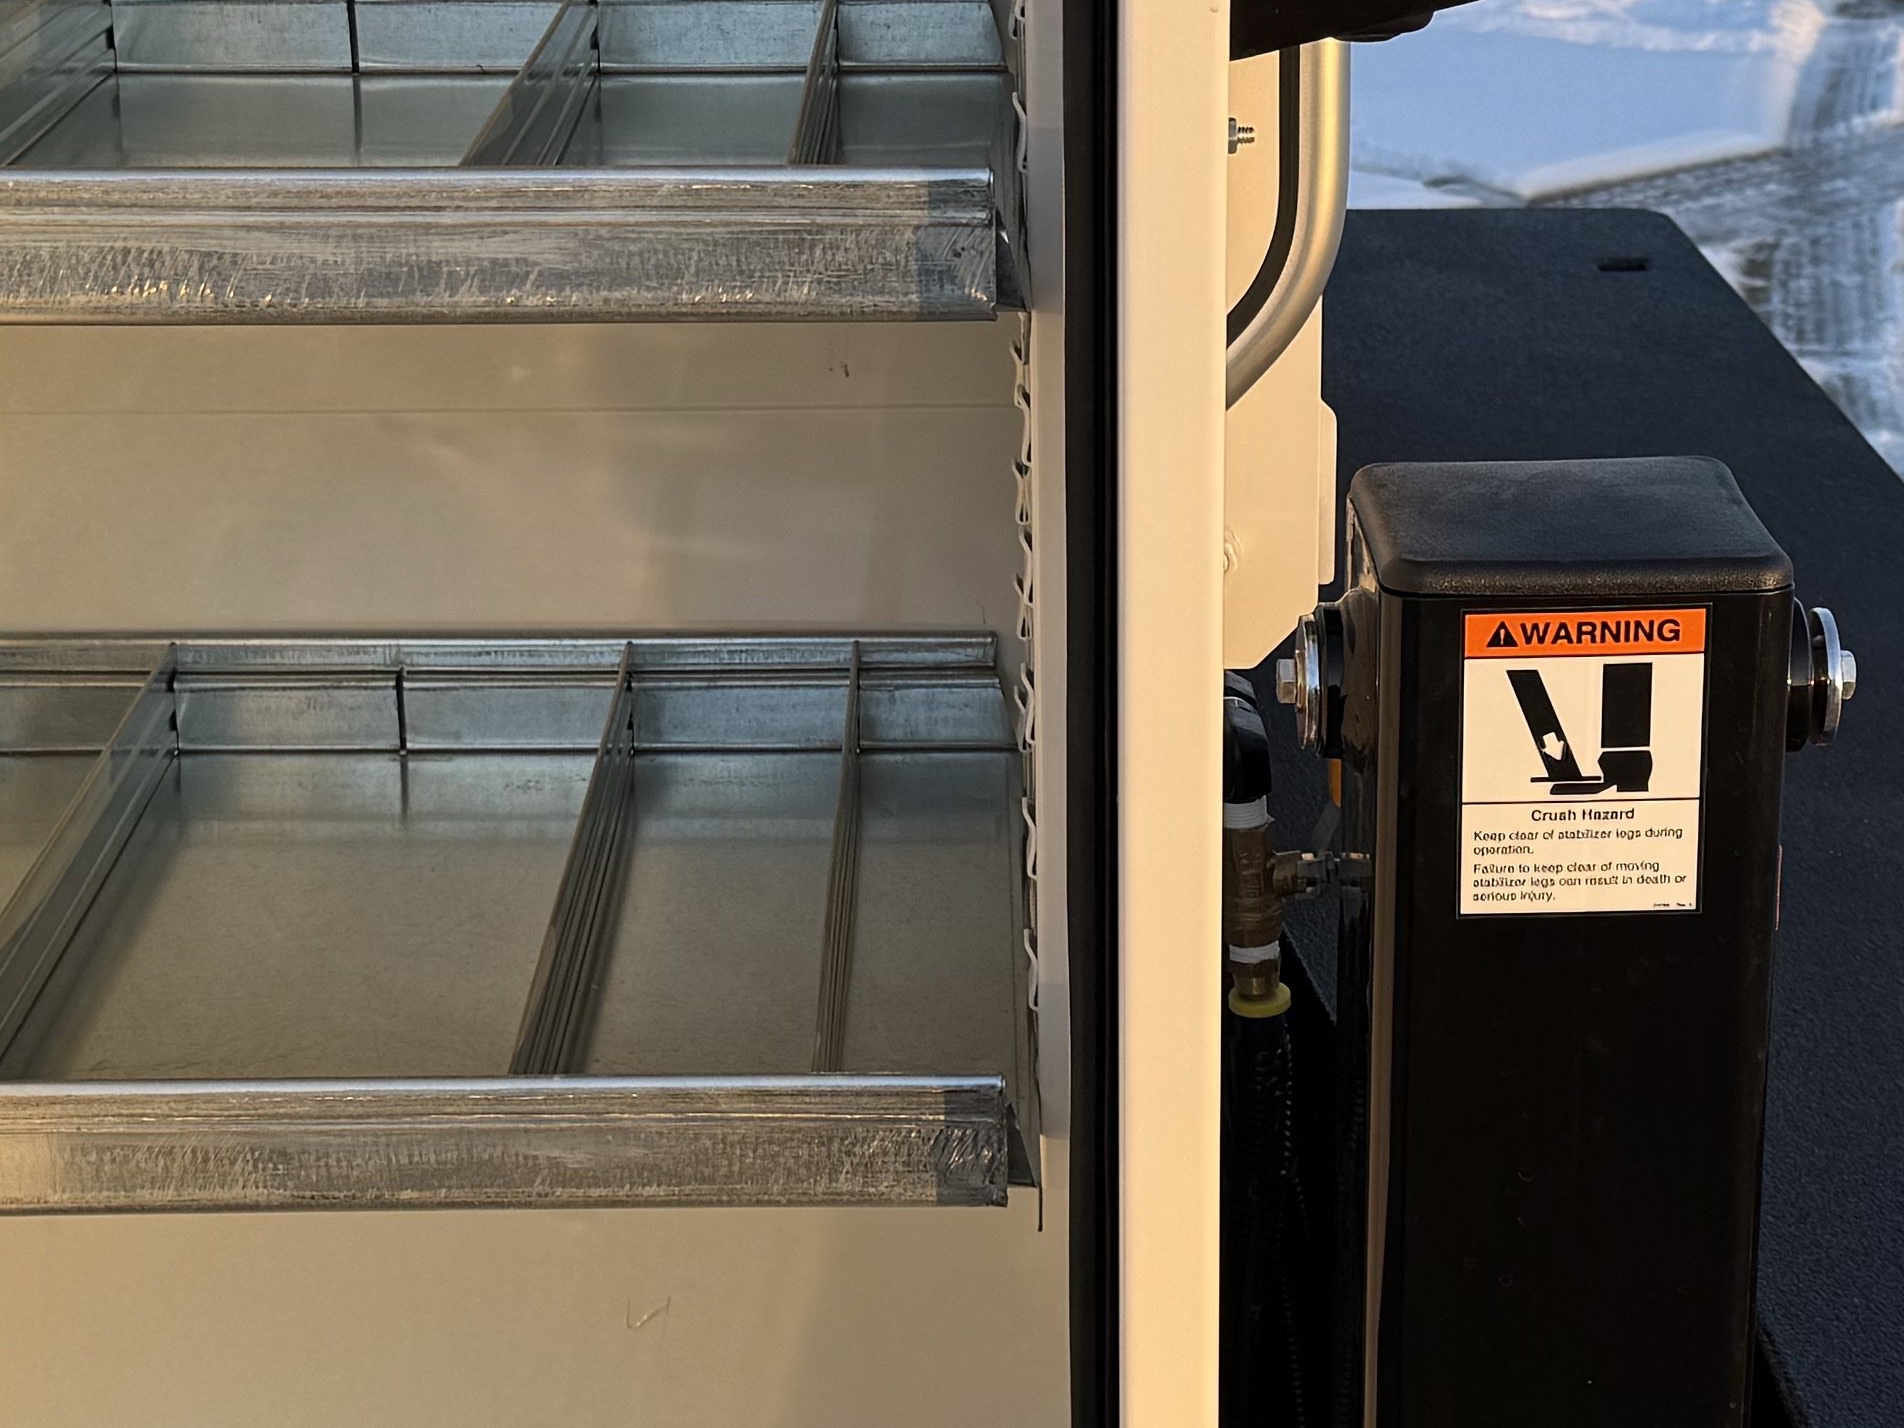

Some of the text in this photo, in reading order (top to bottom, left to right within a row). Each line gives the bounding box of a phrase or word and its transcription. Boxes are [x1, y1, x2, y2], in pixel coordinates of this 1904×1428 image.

[1519, 618, 1681, 645] WARNING
[1530, 807, 1635, 822] Crush Hazard
[1473, 827, 1683, 843] Keep clear of stabilizer legs during
[1473, 844, 1535, 857] operation.
[1473, 860, 1660, 875] Failure to keep clear of moving
[1472, 874, 1687, 889] stabilizer legs can result in death or
[1472, 890, 1556, 902] serious injury.
